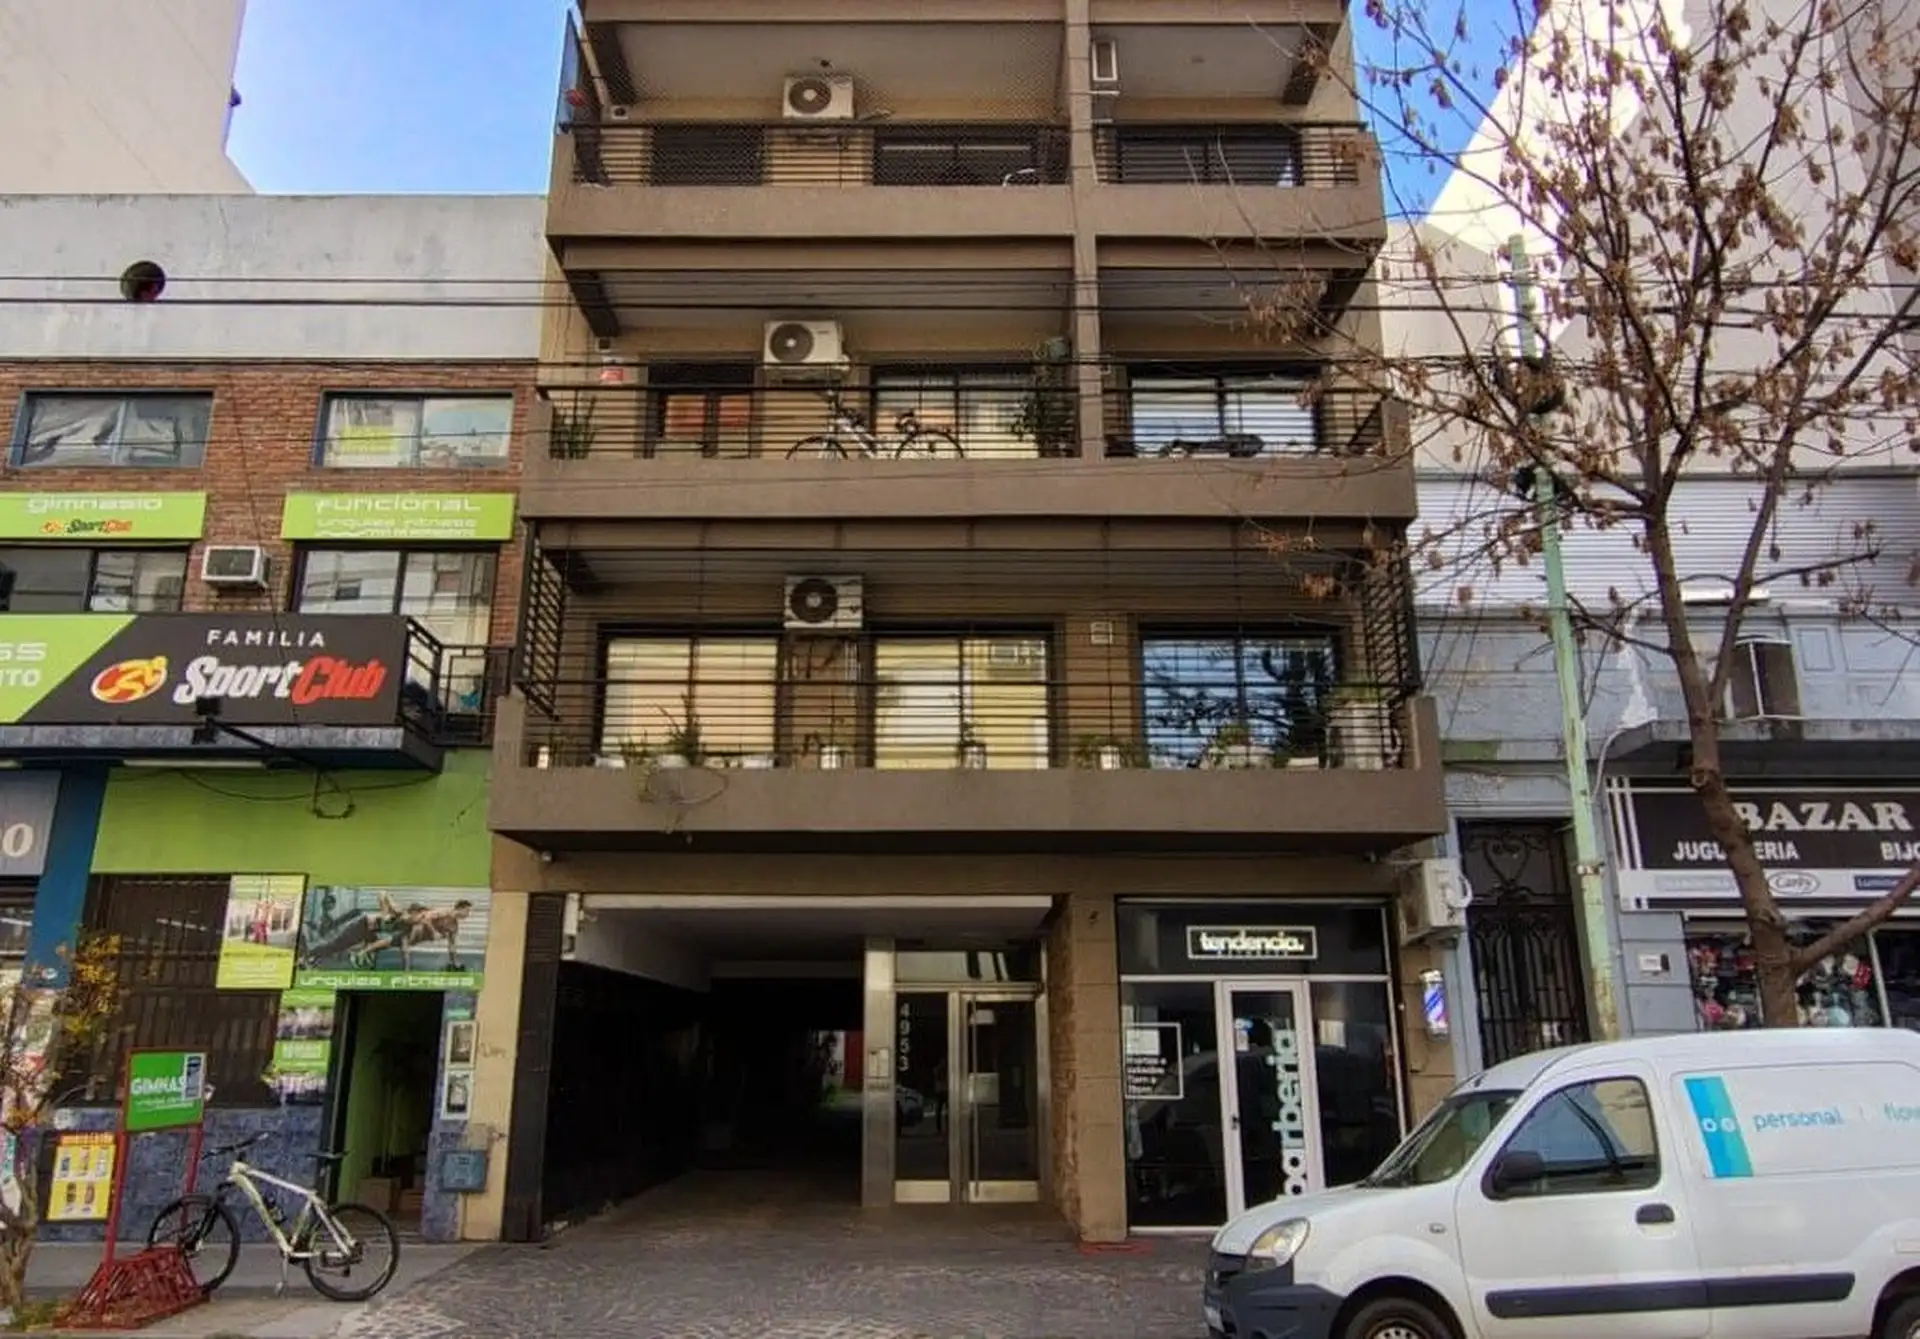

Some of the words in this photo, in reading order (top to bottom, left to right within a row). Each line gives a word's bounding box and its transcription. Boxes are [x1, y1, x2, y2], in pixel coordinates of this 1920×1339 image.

[206, 629, 325, 647] FAMILIA
[1732, 802, 1914, 830] BAZAR
[1672, 841, 1799, 860] JUGUERIA
[1752, 1108, 1844, 1131] personal
